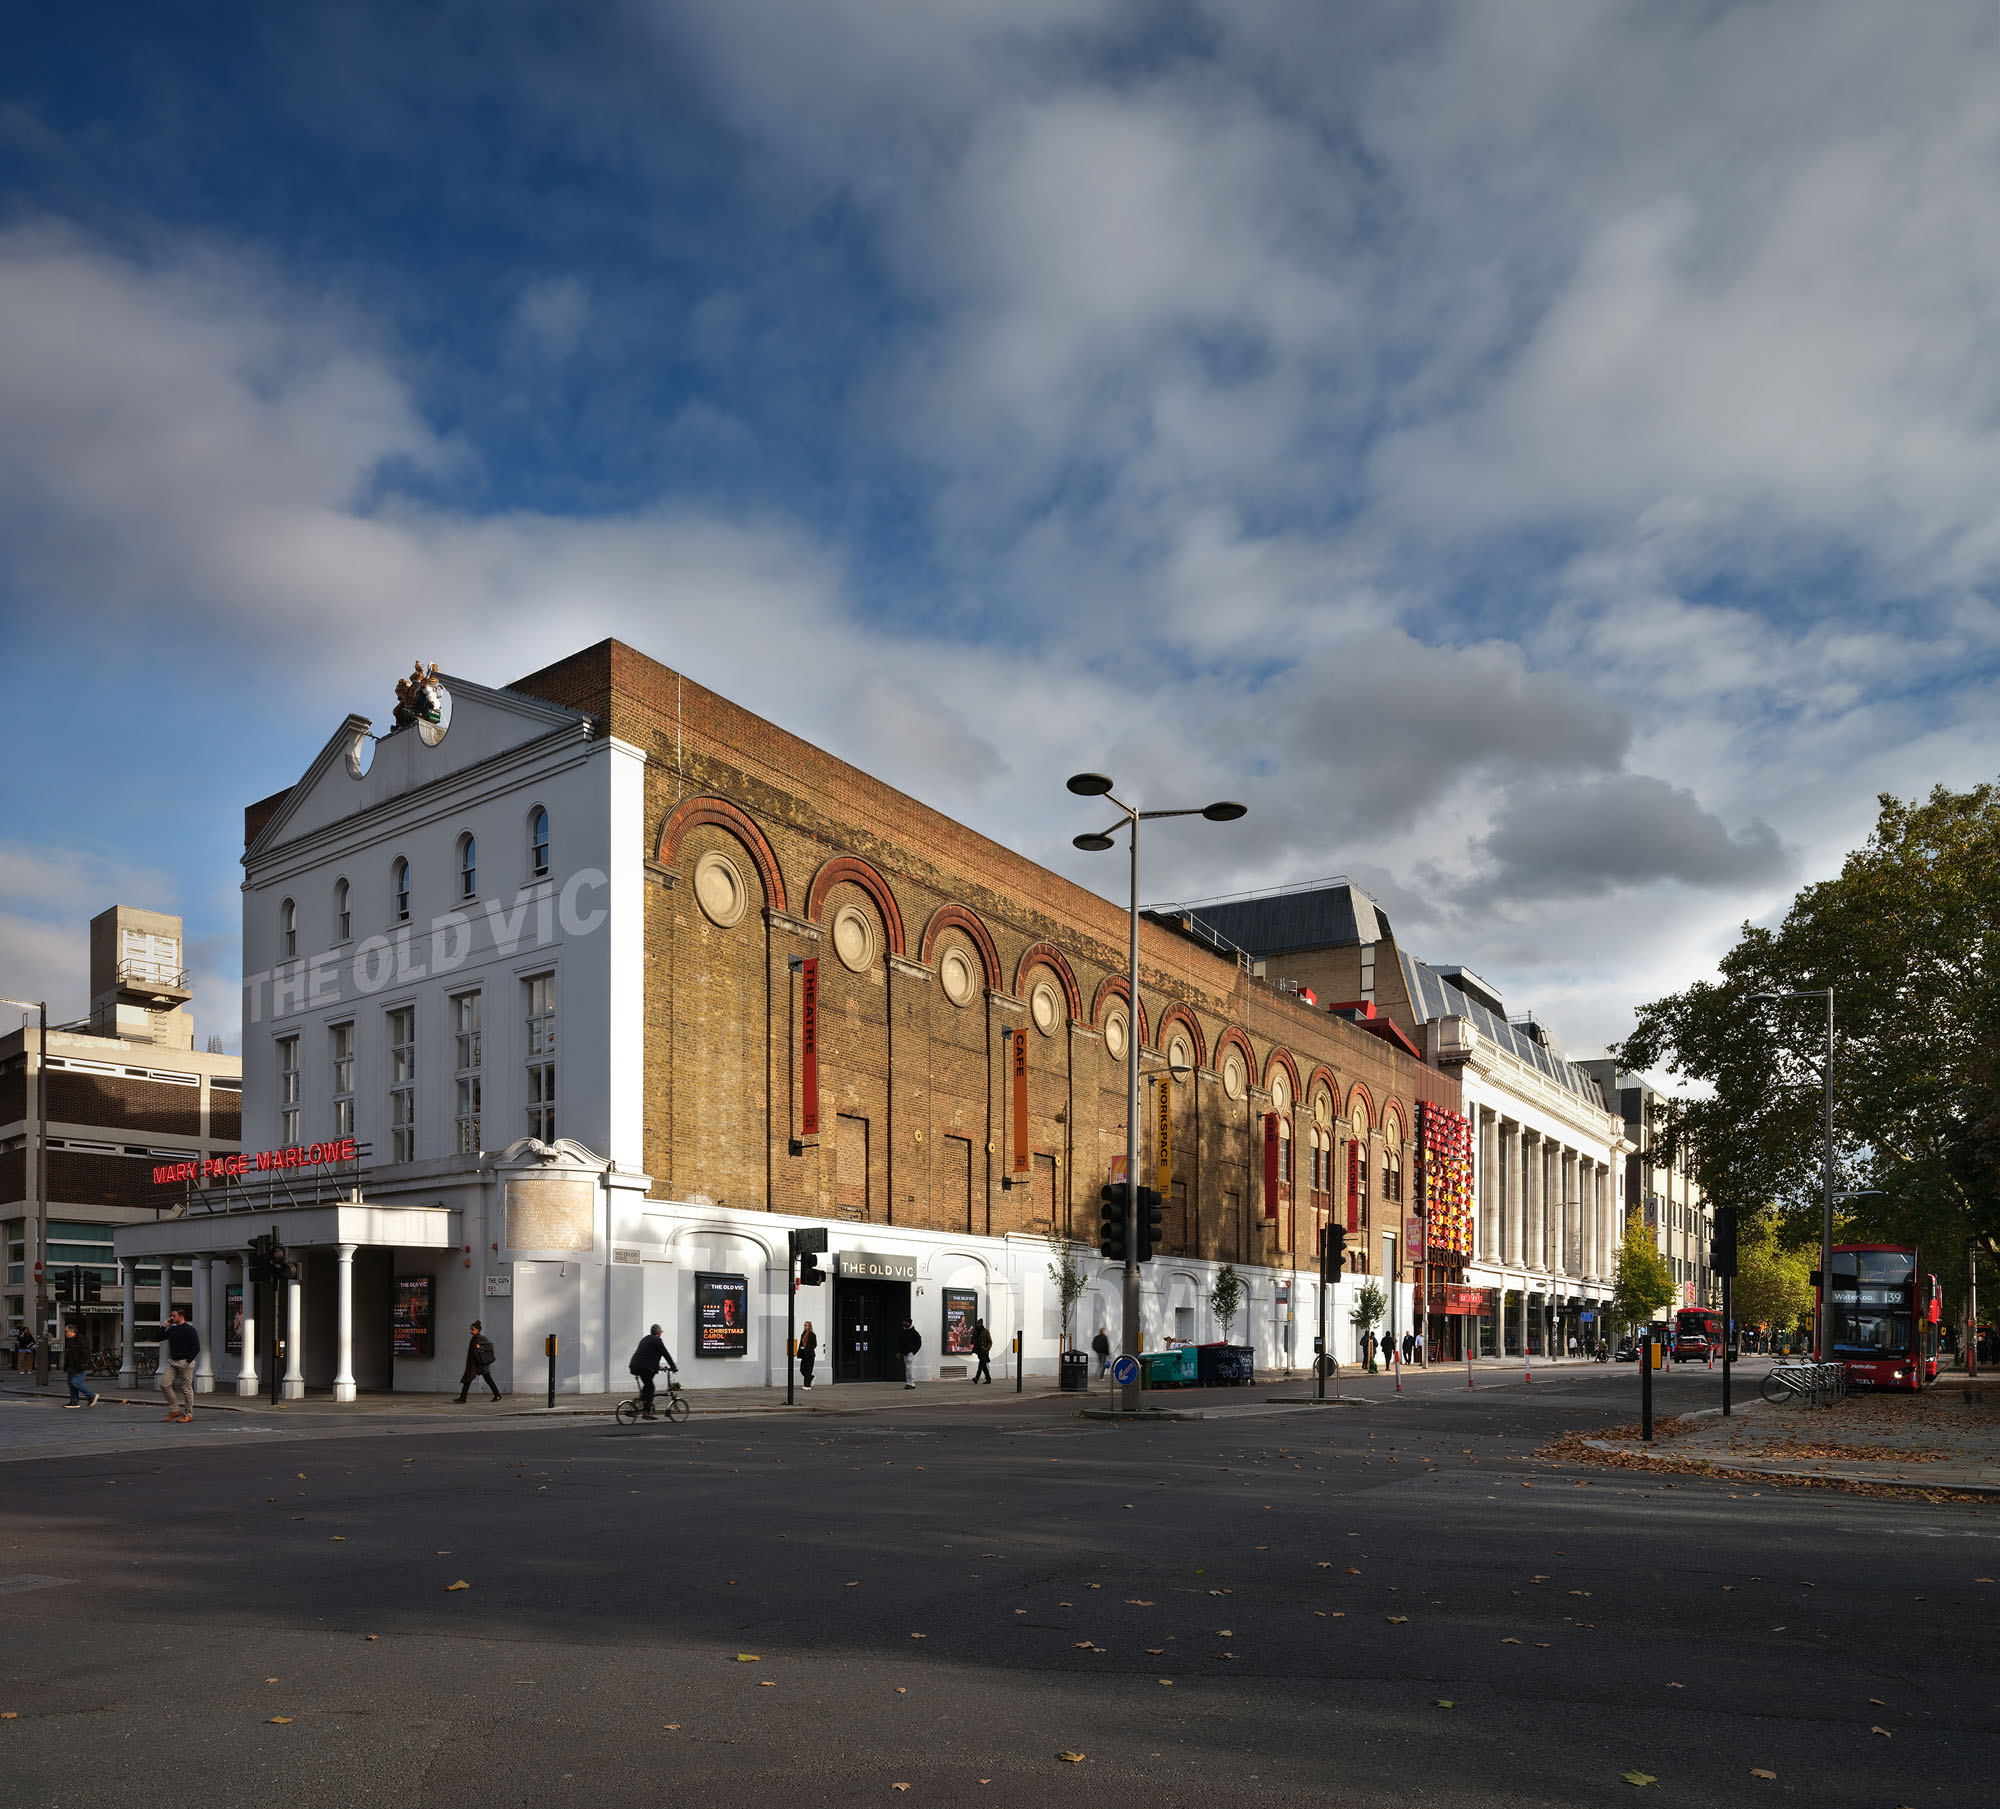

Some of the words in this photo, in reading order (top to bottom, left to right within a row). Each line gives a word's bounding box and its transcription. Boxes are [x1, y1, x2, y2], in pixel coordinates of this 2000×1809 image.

[243, 949, 341, 1024] THE
[353, 911, 472, 993] OLD
[485, 868, 608, 957] VIC
[806, 965, 815, 1054] THEATRE
[1016, 1034, 1024, 1077] CAFE
[1160, 1083, 1168, 1167] WORKSPACE
[153, 1162, 198, 1184] MARY
[204, 1154, 249, 1178] PAGE
[256, 1138, 356, 1171] MARLOWE
[842, 1262, 866, 1274] THE
[869, 1264, 892, 1275] OLD
[895, 1266, 914, 1277] VIC
[1443, 1250, 1458, 1266] OLD
[1884, 1292, 1901, 1303] 139
